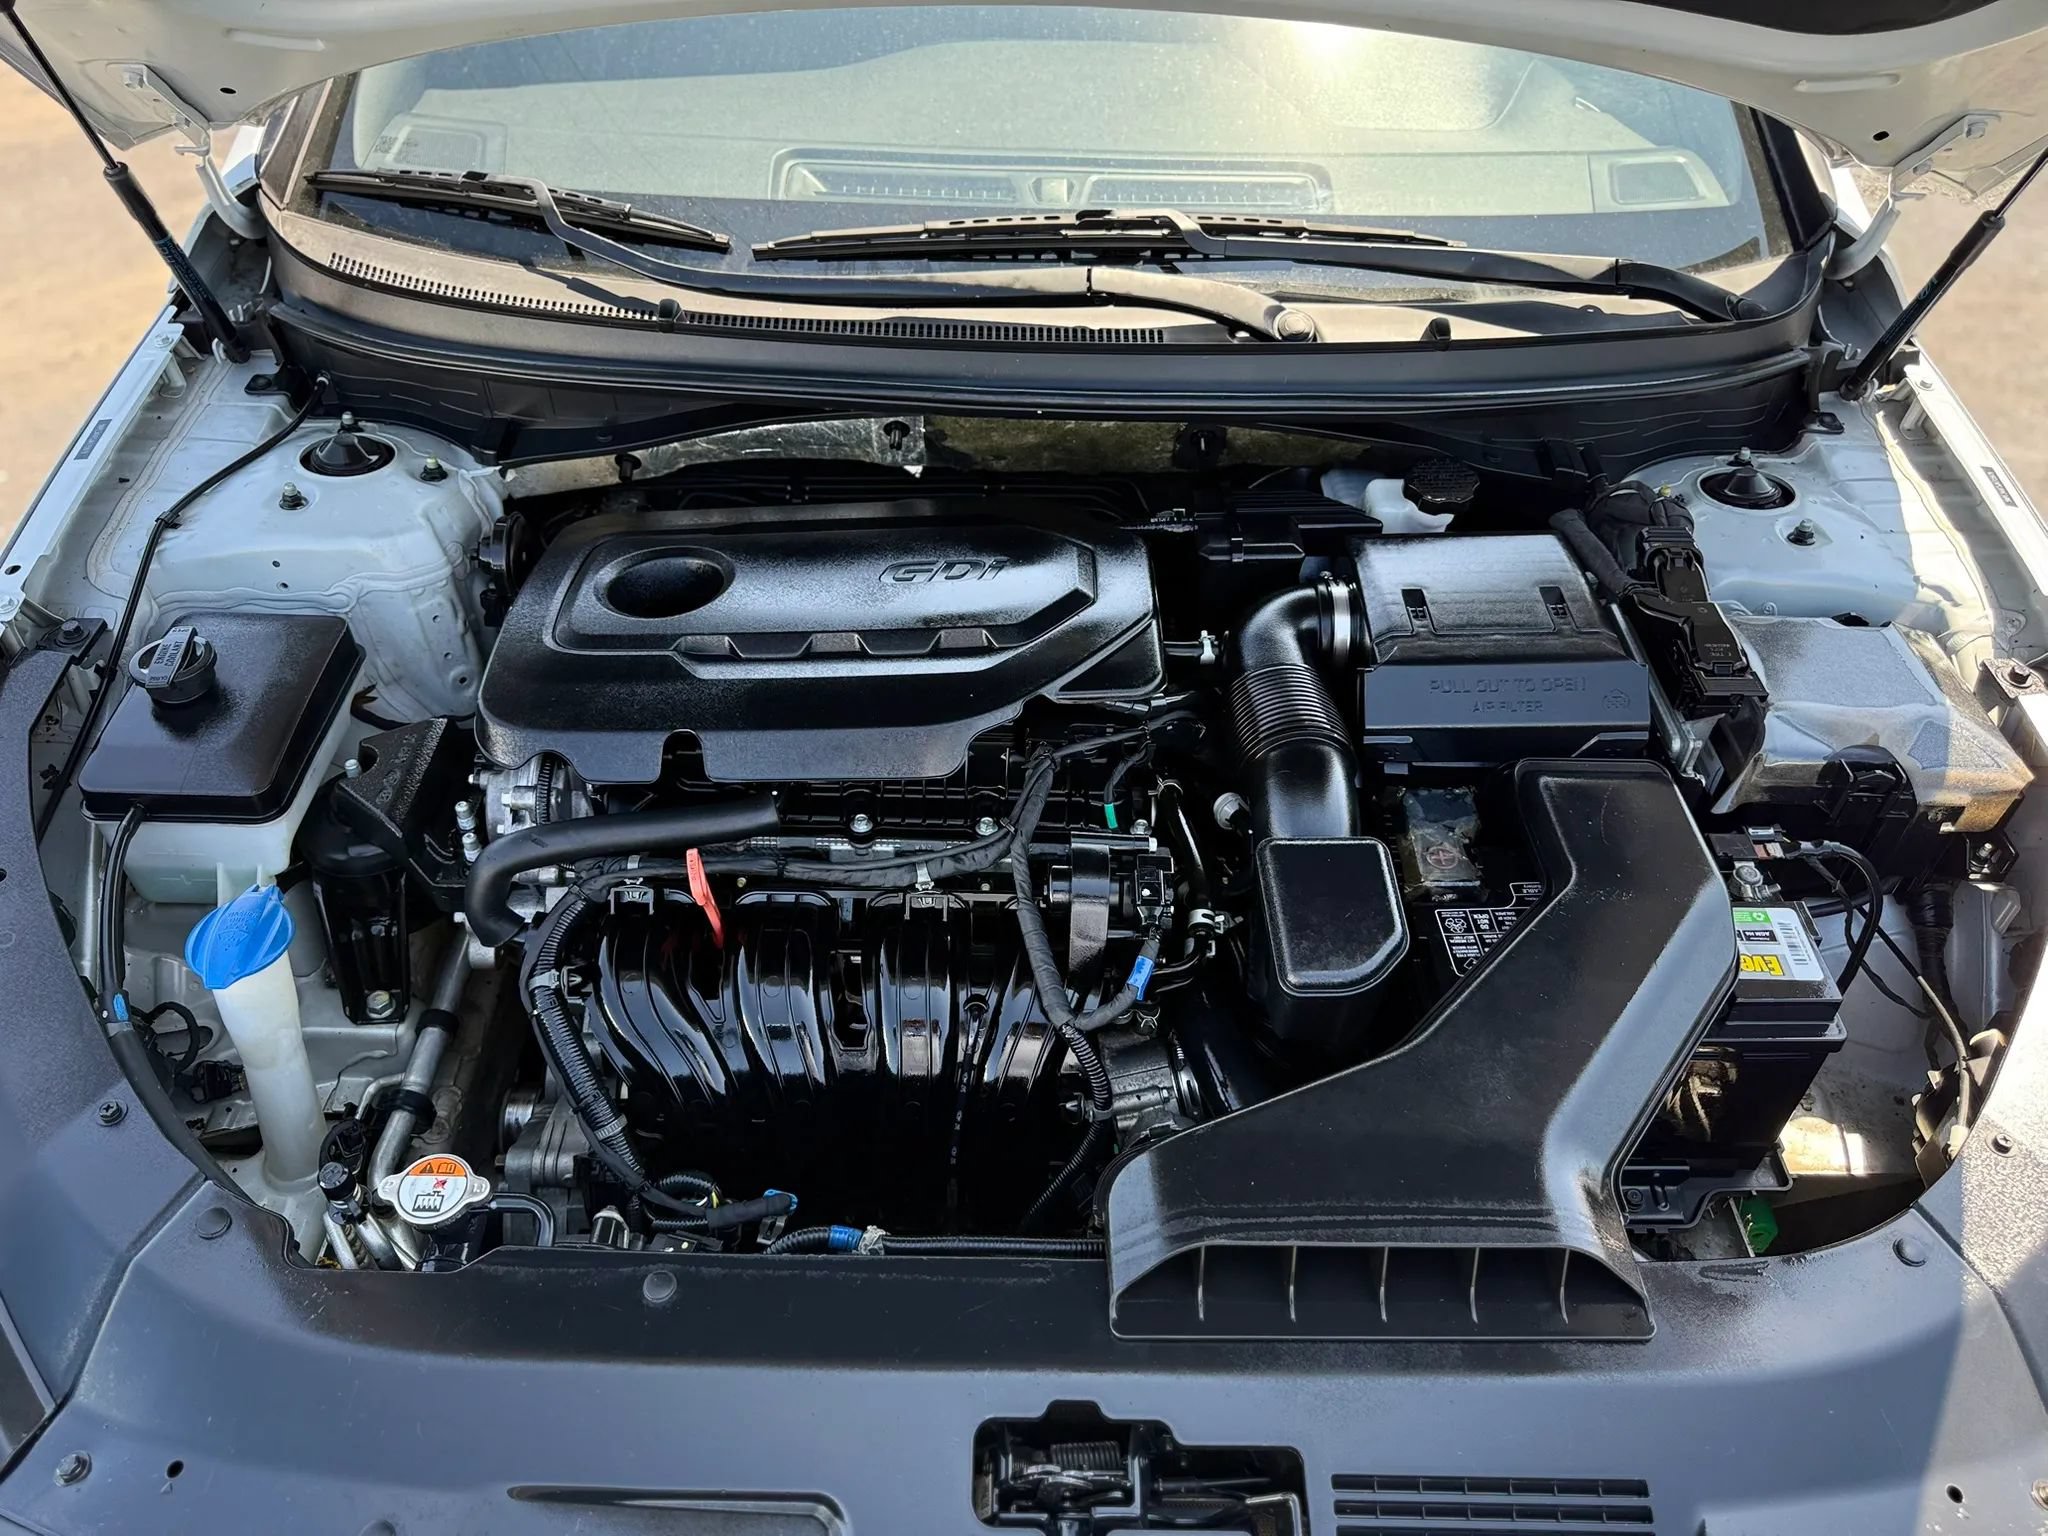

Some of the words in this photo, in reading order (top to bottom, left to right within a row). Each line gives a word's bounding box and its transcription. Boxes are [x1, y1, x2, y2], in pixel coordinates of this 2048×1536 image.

[154, 643, 172, 665] ENGINE
[164, 641, 184, 667] COOLANT
[1429, 679, 1471, 694] PULL
[1476, 678, 1510, 693] OUT
[1513, 678, 1536, 692] TO
[1542, 676, 1586, 692] OPEN
[1472, 701, 1496, 713] AIR
[1500, 700, 1544, 713] FILTER
